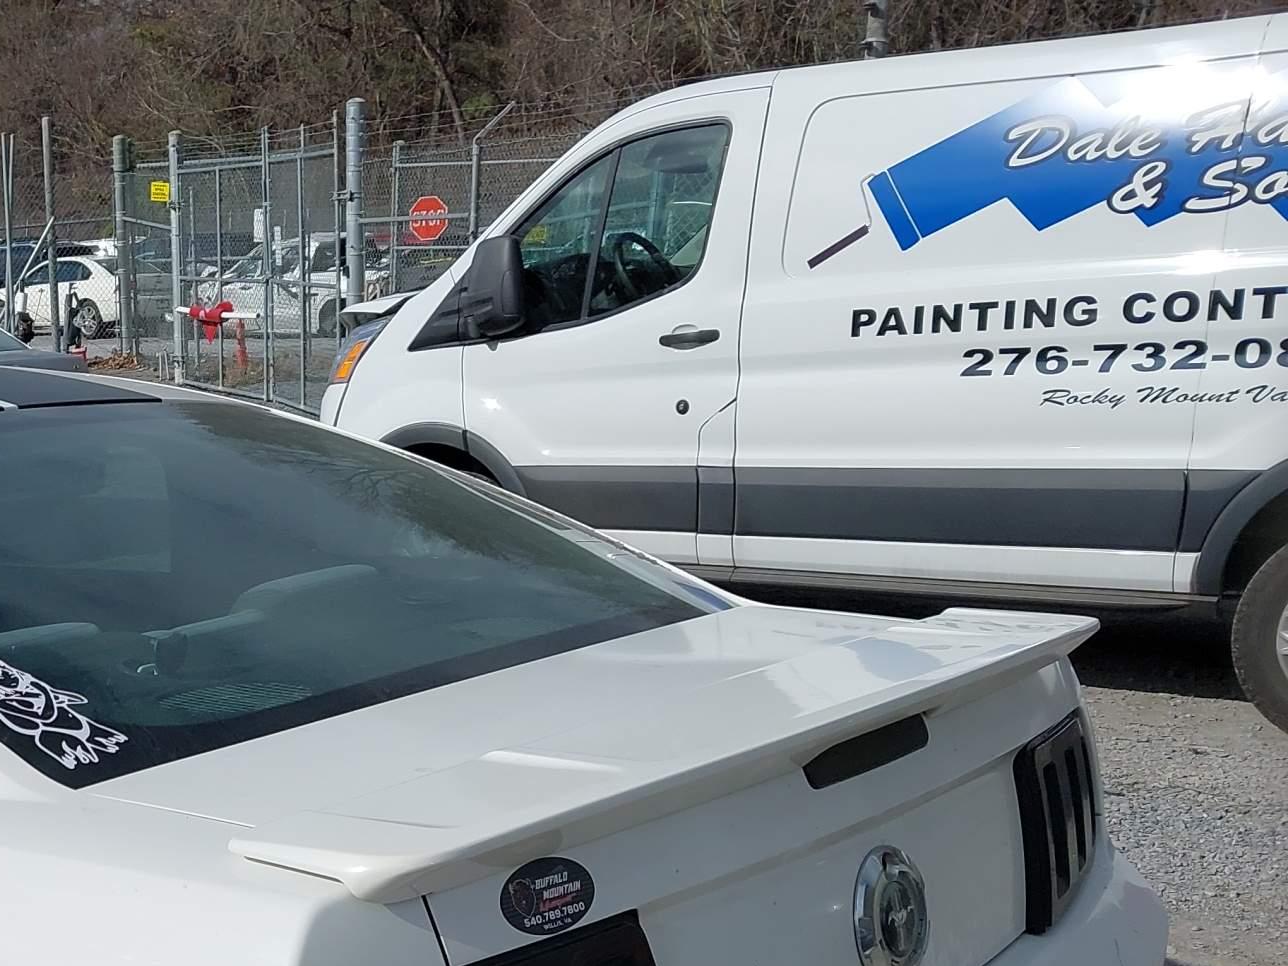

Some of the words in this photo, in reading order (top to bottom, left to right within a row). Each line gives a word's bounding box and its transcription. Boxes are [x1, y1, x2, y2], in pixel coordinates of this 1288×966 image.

[1006, 115, 1163, 168] Dale
[1108, 159, 1168, 213] &
[412, 209, 445, 227] STOP
[850, 294, 1098, 338] PAINTING
[1122, 286, 1288, 324] CONT
[1040, 388, 1126, 410] Rocky
[1136, 386, 1241, 404] Mount
[535, 871, 568, 890] BUFFALO
[543, 879, 581, 900] MOUNTAIN
